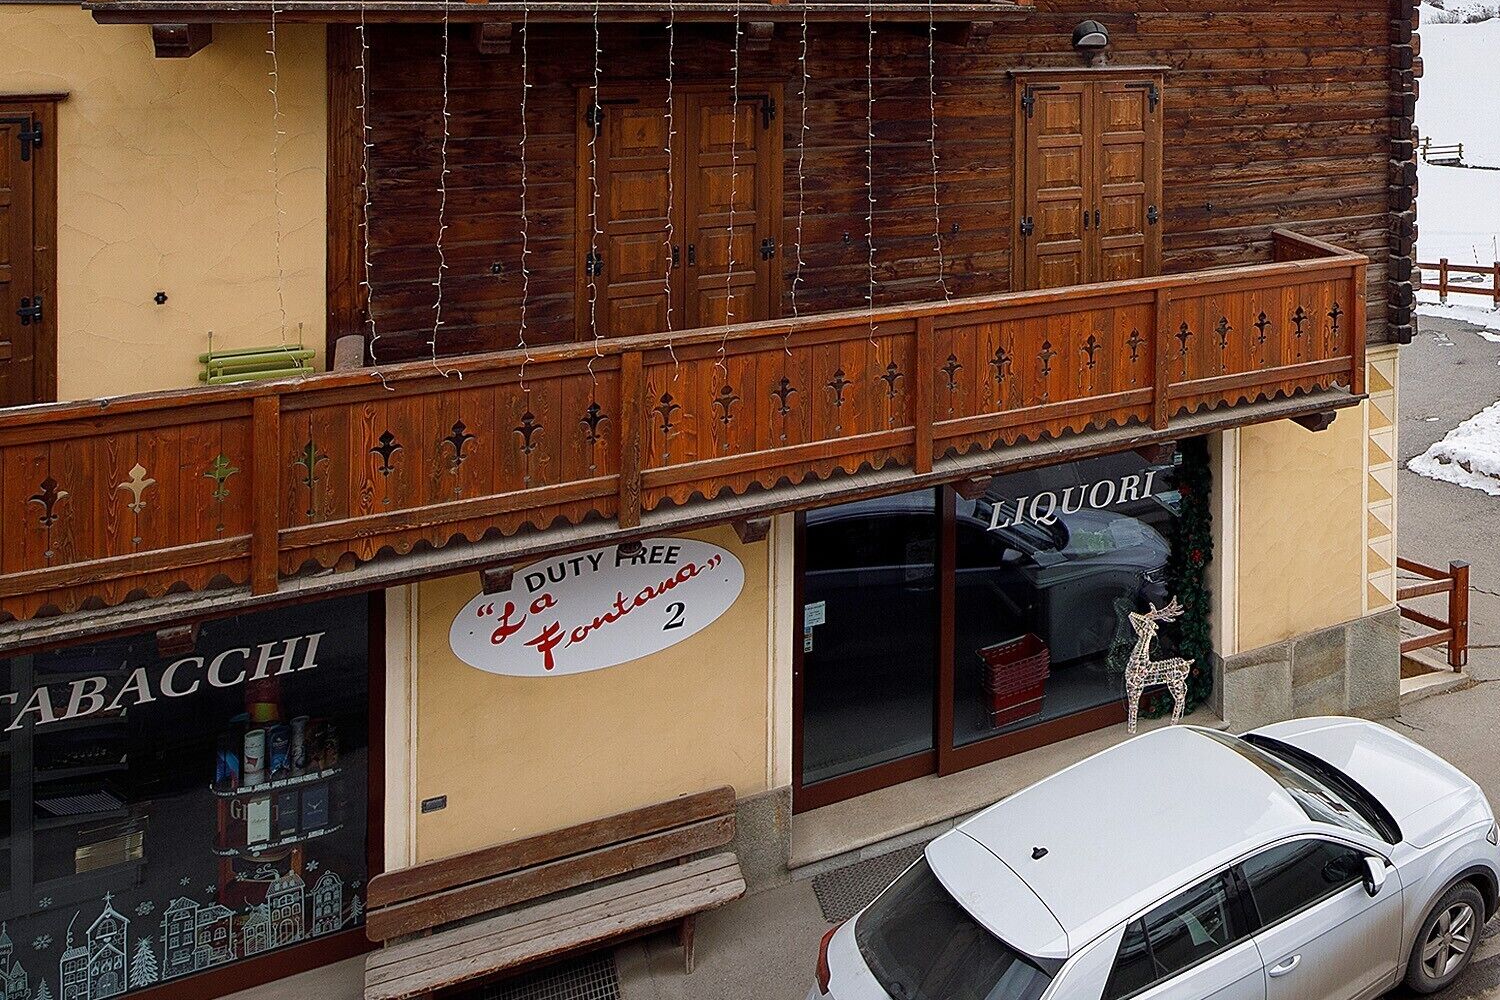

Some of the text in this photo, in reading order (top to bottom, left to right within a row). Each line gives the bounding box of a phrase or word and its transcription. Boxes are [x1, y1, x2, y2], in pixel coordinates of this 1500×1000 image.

[986, 470, 1157, 532] LIQUORI
[524, 551, 604, 593] DUTY
[662, 601, 686, 631] 2
